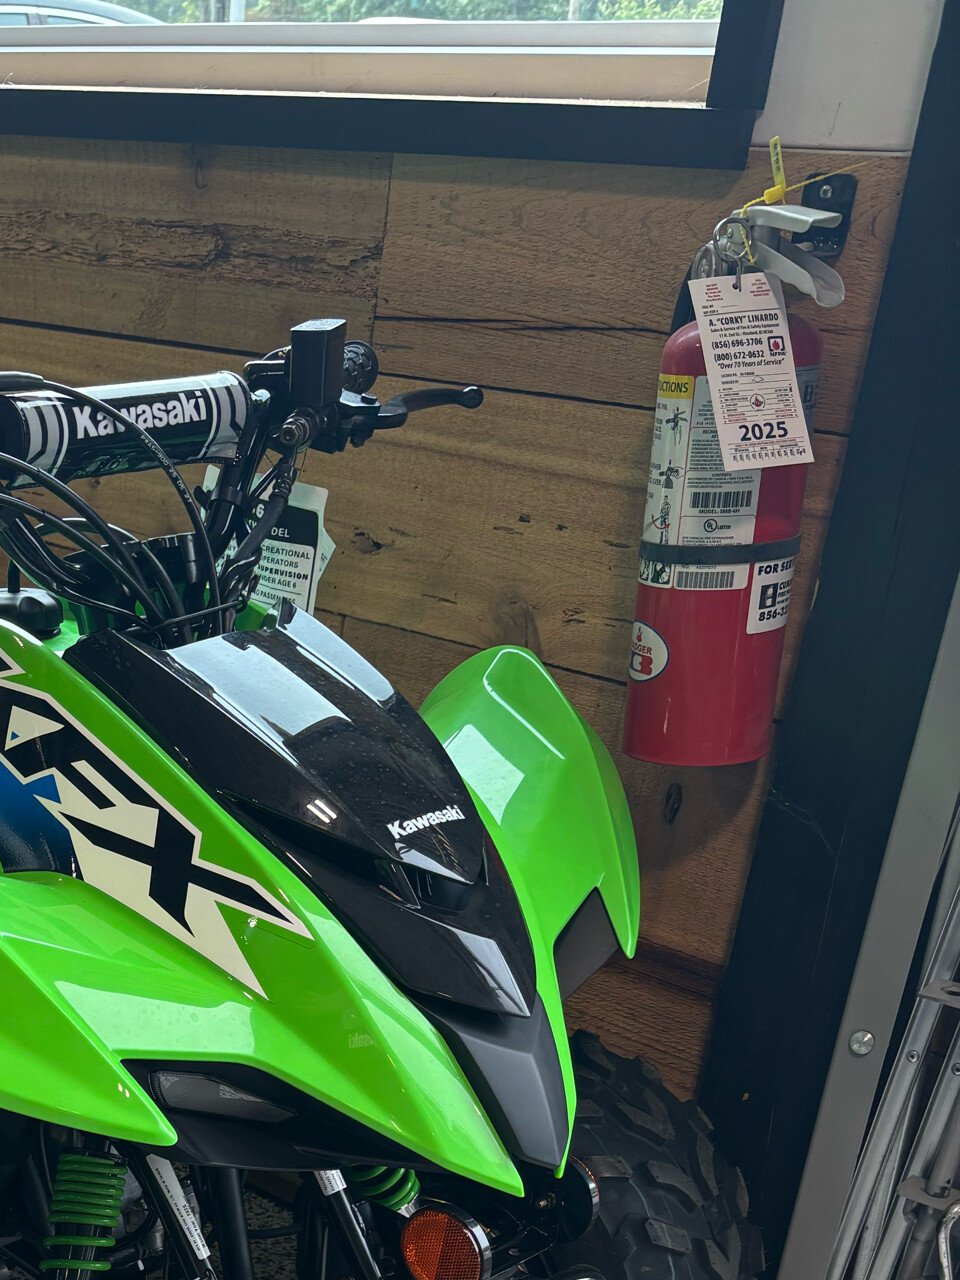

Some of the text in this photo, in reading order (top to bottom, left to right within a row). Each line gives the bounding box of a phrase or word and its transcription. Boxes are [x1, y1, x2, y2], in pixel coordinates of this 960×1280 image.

[717, 315, 747, 326] "CORKY"
[747, 313, 779, 323] LINARDO
[711, 338, 763, 350] (856) 696-3706
[714, 350, 765, 363] (800) 672-0632
[742, 360, 756, 368] Years
[72, 391, 207, 440] Kawasaki
[738, 421, 789, 442] 2025
[271, 526, 291, 538] DEL
[261, 544, 311, 560] CREATIONAL
[261, 556, 300, 569] PERATORS
[758, 563, 779, 576] FOR
[277, 577, 292, 589] AGE
[386, 804, 466, 840] Kawasaki
